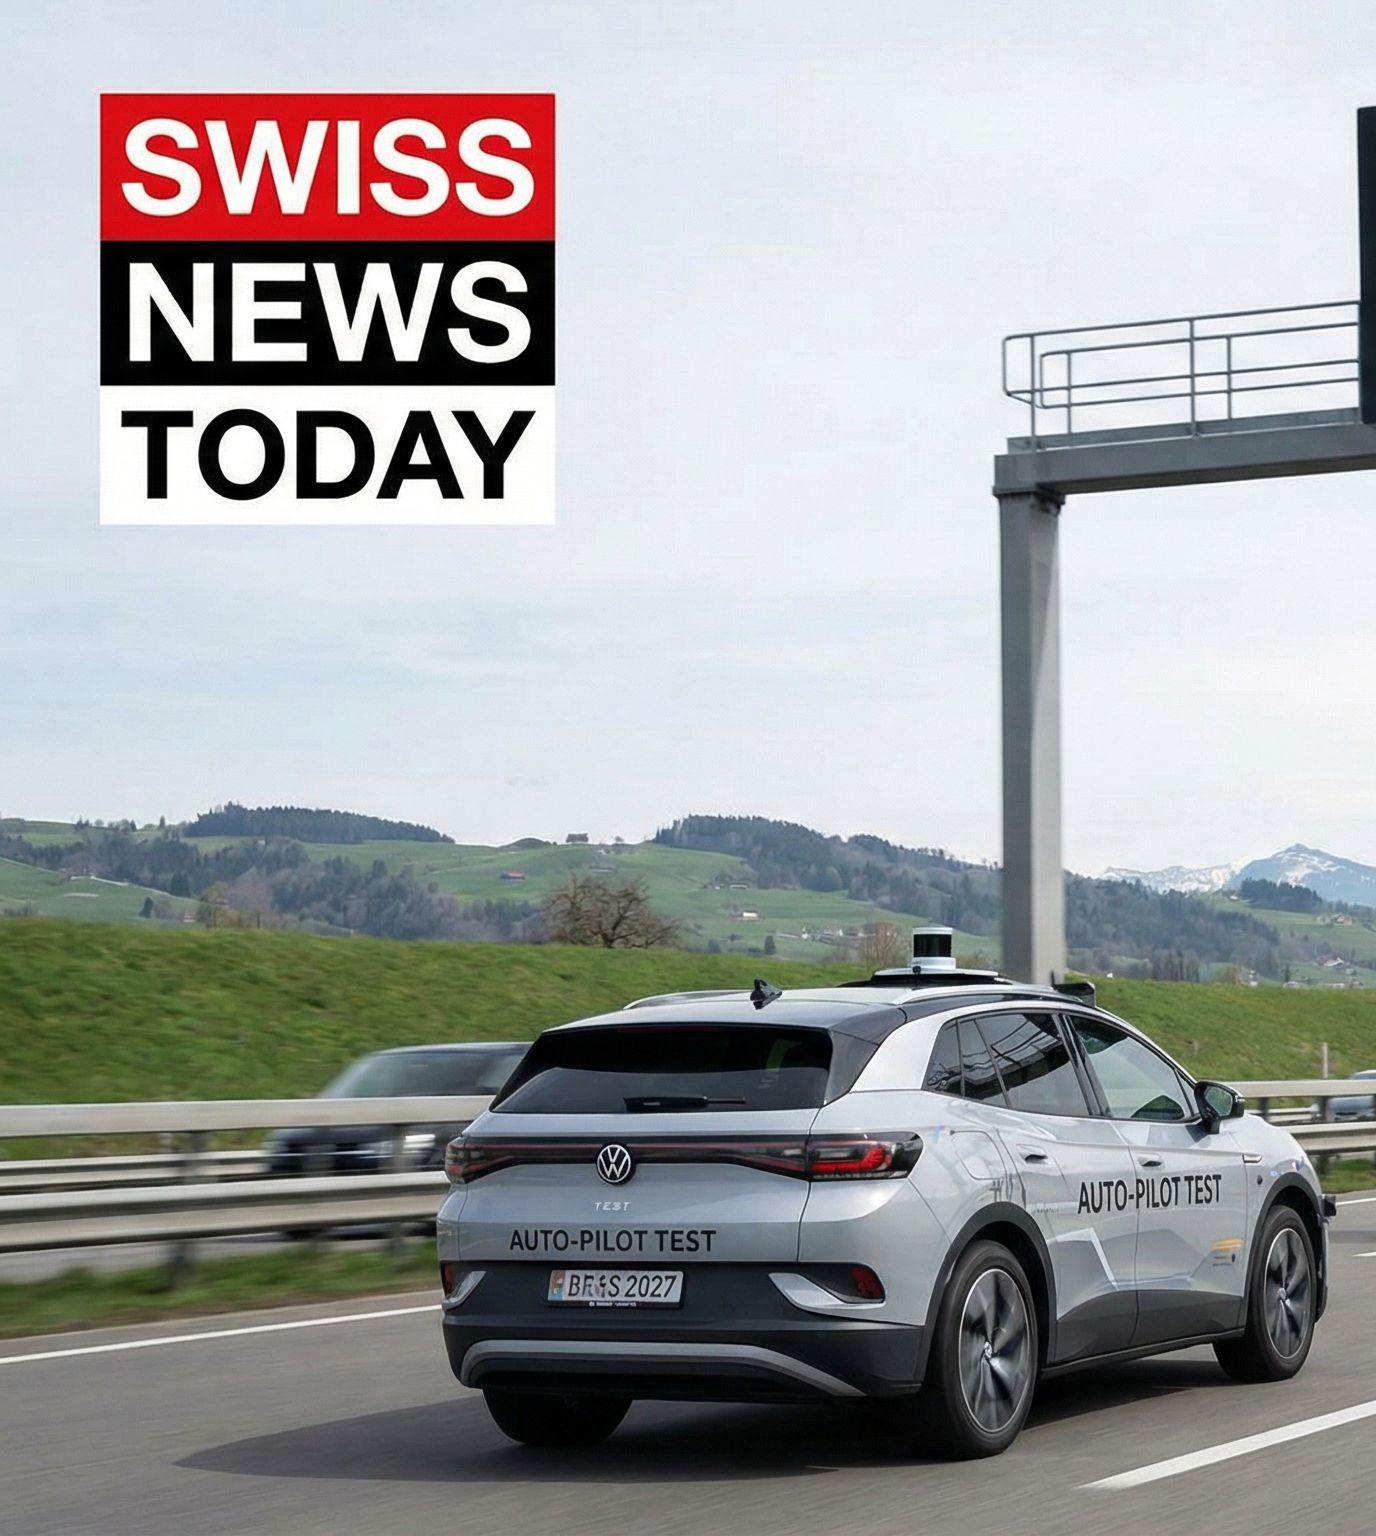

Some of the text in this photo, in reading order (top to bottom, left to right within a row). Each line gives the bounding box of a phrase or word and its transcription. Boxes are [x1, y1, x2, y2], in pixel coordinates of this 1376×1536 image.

[1077, 1175, 1221, 1214] AUTO-PILOT TEST
[510, 1230, 717, 1252] AUTO-PILOT TEST
[624, 1274, 677, 1298] 2027
